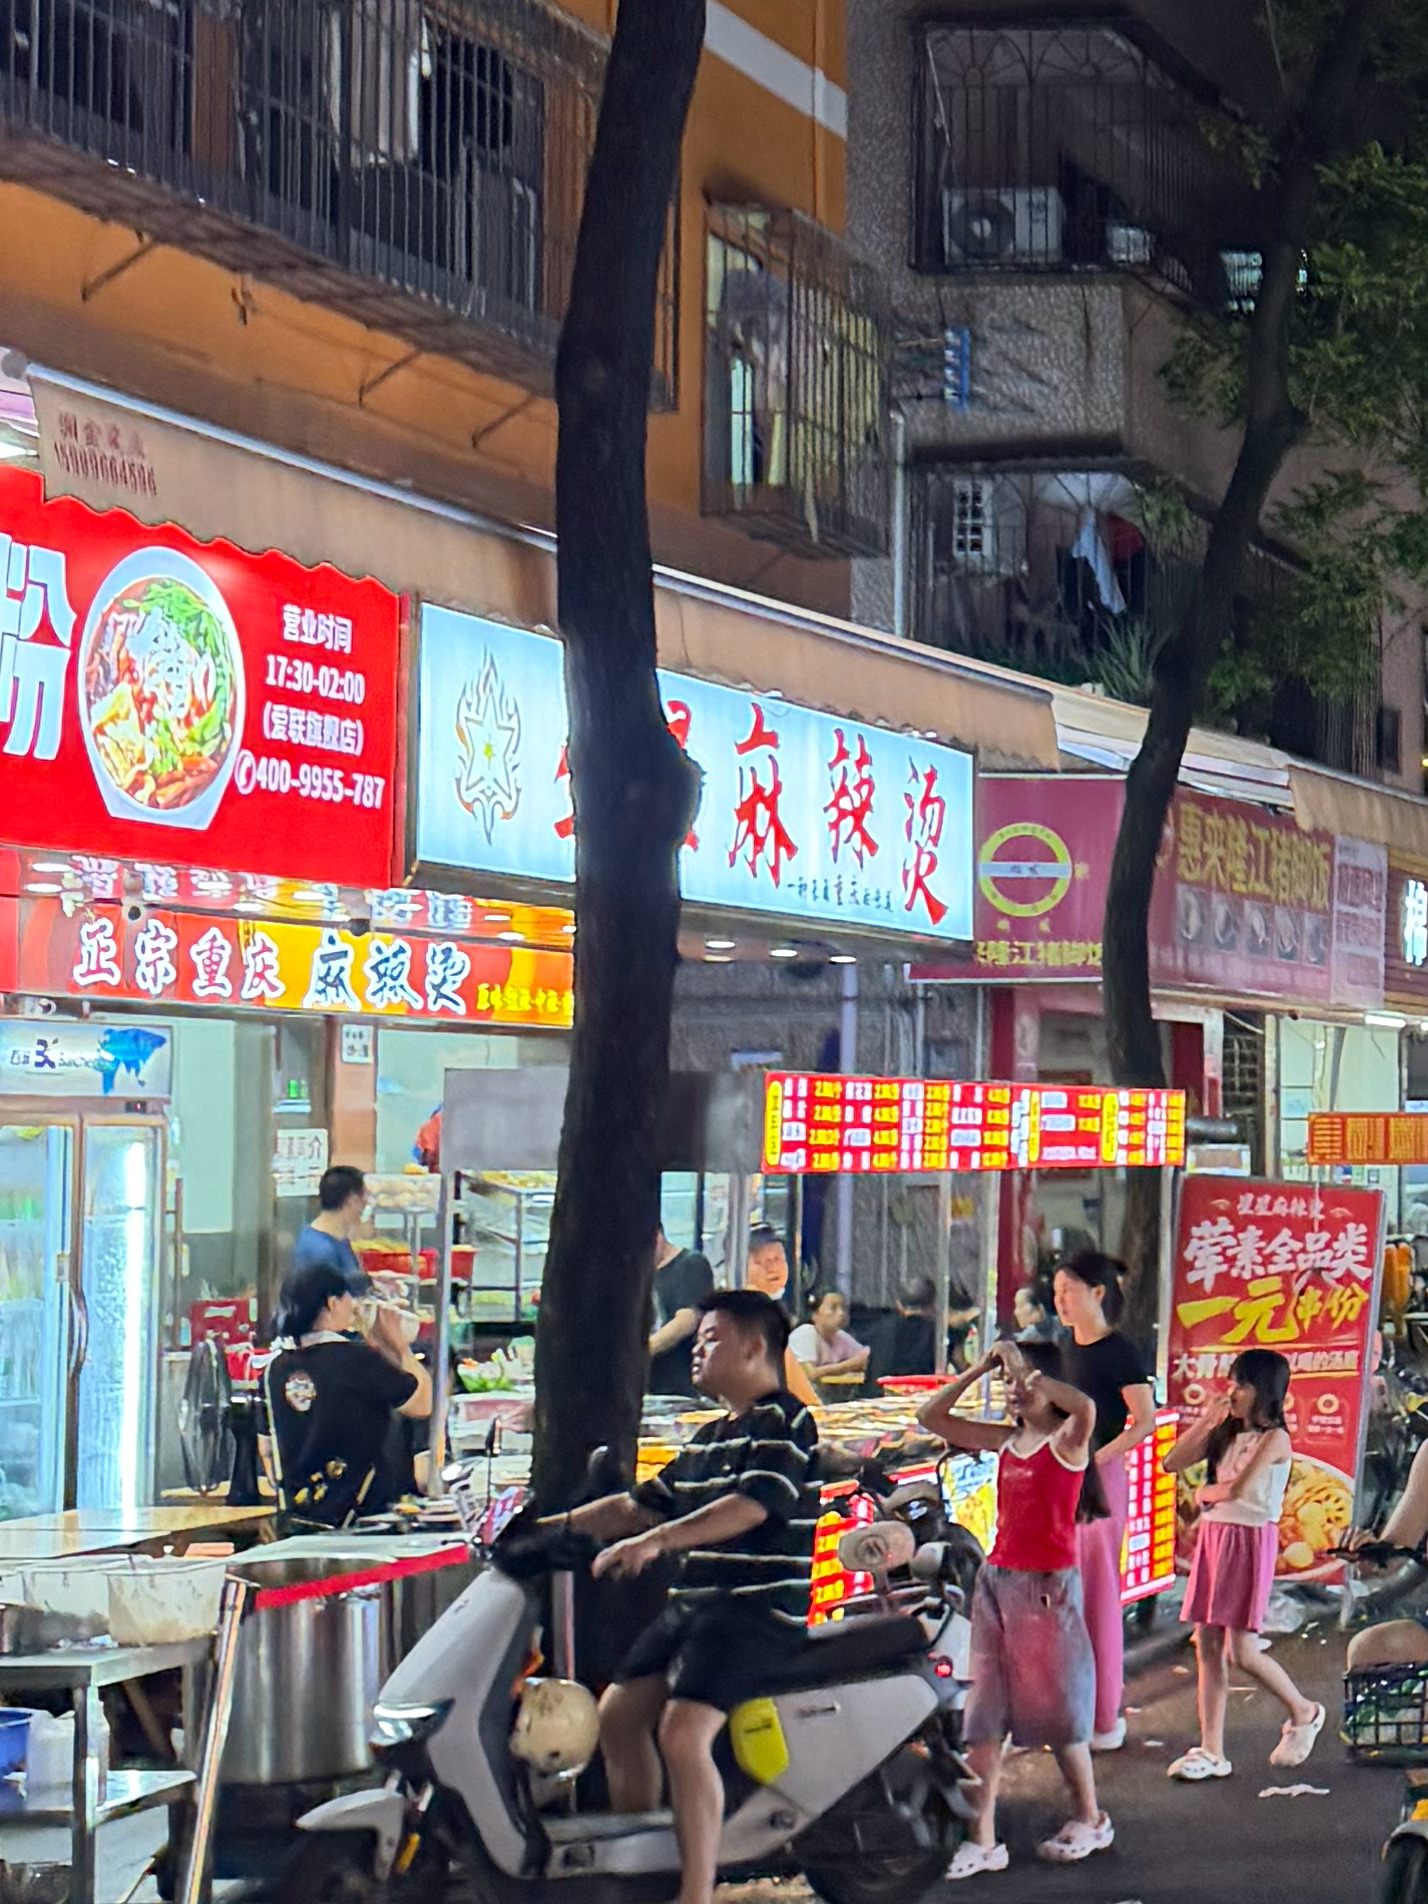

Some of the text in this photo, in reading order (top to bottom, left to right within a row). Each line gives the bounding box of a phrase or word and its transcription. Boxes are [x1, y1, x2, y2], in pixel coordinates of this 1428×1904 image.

[283, 603, 352, 654] 营业时间
[265, 654, 366, 705] 17:30-02:00
[256, 756, 386, 810] 400-9955-787
[667, 699, 948, 925] 麻辣烫
[1184, 1219, 1373, 1294] 荤素全品类
